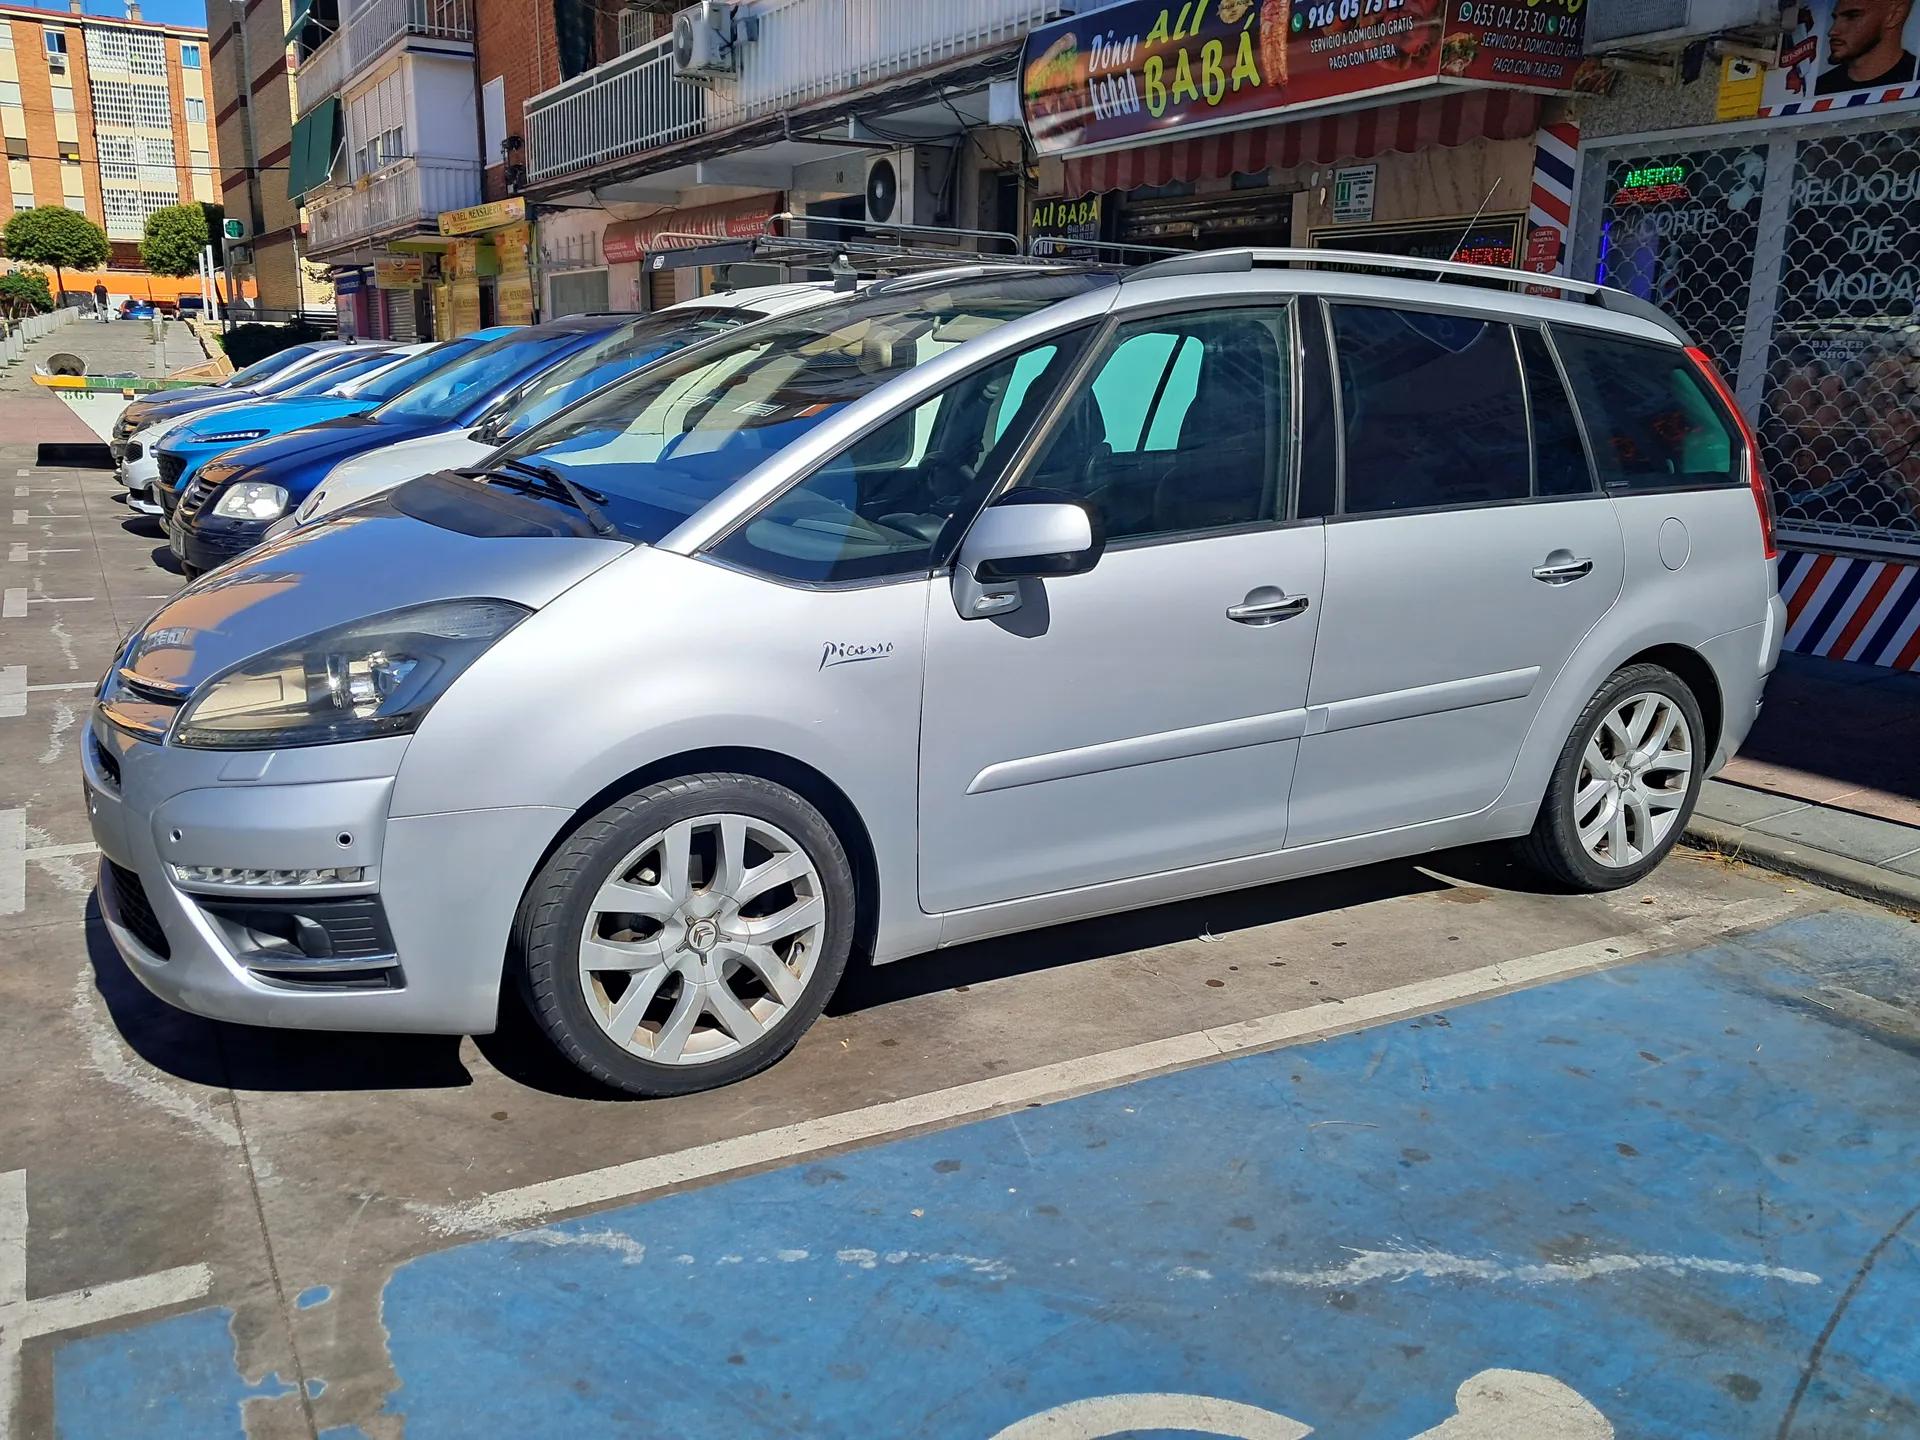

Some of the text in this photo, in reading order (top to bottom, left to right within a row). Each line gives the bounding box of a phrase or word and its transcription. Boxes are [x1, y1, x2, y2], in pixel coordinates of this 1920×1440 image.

[1145, 0, 1209, 48] ALI
[1308, 4, 1335, 29] 916
[1340, 0, 1359, 21] 05
[1473, 3, 1496, 25] 653
[1497, 6, 1513, 29] 04
[1514, 8, 1529, 32] 23
[1530, 11, 1546, 33] 30
[1558, 15, 1577, 38] 916
[1310, 15, 1414, 53] SERVICIO A DOMICILIO GRATIS
[1481, 31, 1517, 50] SERVICIO
[1517, 37, 1523, 50] A
[1523, 37, 1564, 56] DOMICILIO
[1144, 12, 1261, 118] BABÁ
[1329, 55, 1348, 70] PAGO
[1349, 52, 1366, 65] CON
[1492, 57, 1514, 73] PAGO
[1514, 60, 1531, 75] CON
[1624, 166, 1683, 188] ABIERTO
[732, 222, 767, 233] JUGUETE
[1850, 225, 1896, 254] DE
[1815, 271, 1915, 300] MODA
